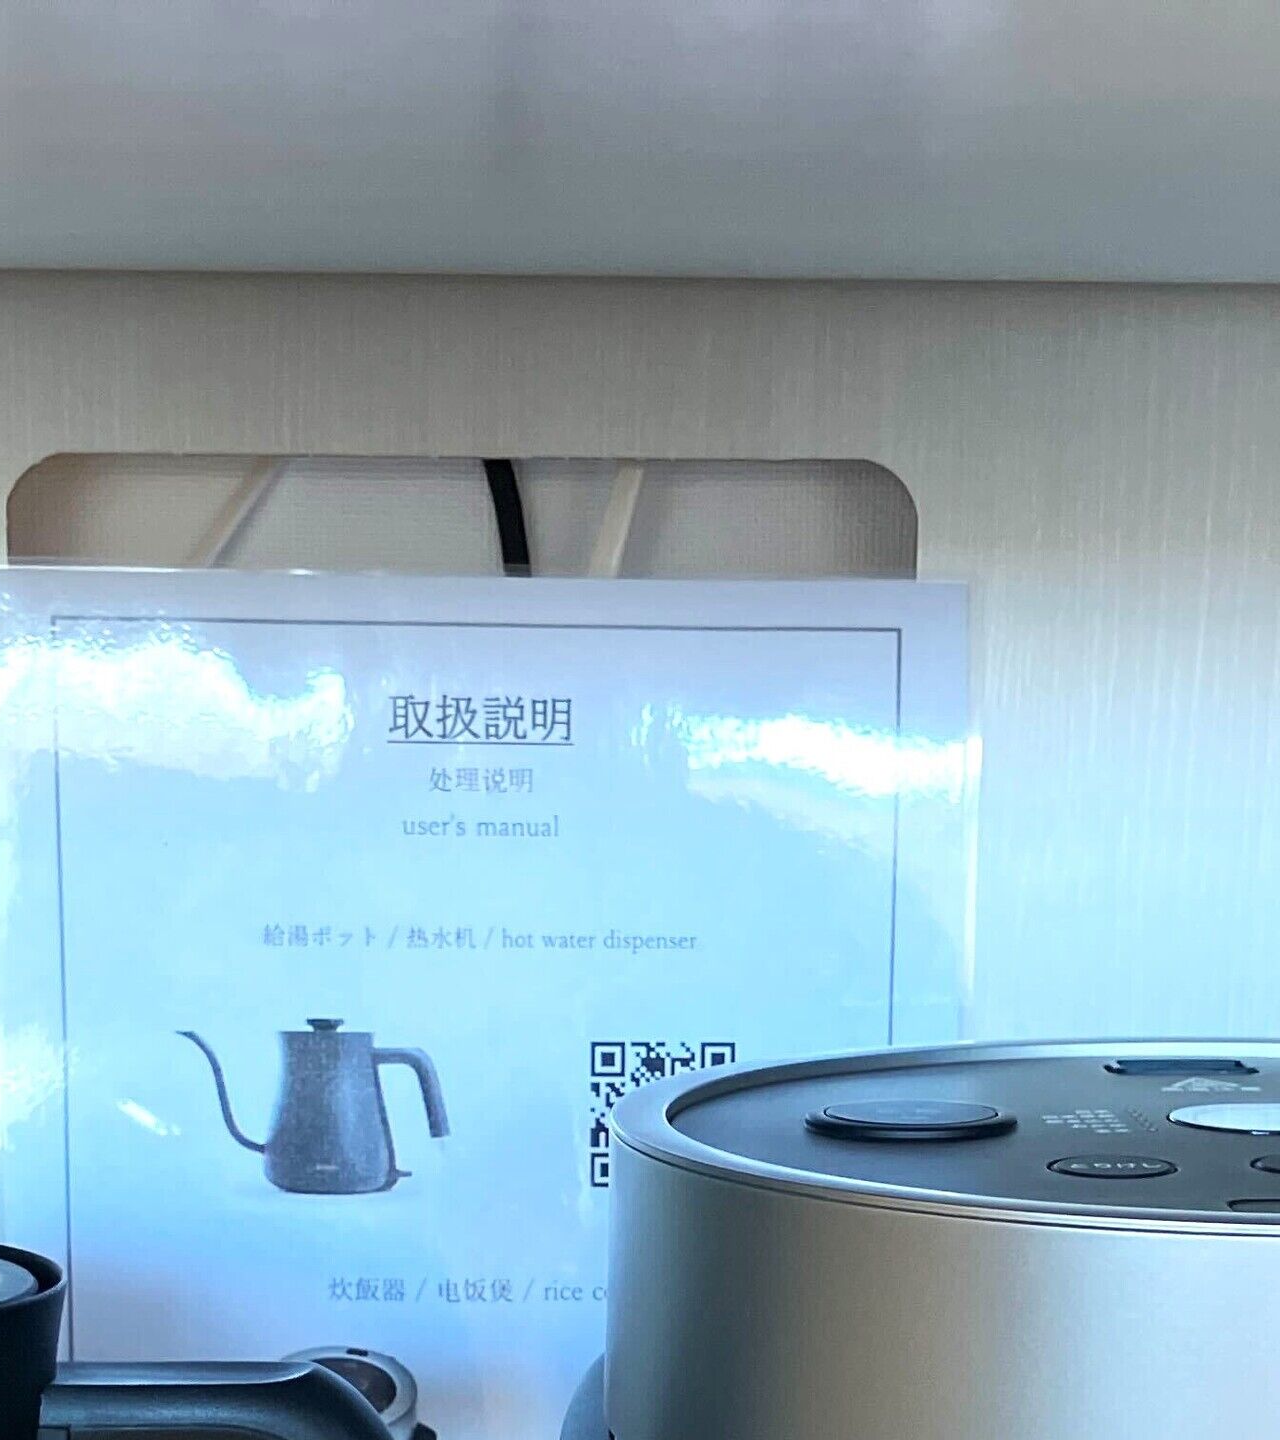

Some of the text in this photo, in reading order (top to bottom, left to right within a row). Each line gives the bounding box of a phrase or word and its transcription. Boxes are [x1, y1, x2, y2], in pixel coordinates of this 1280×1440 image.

[387, 694, 573, 741] 取扱説明
[429, 768, 534, 794] 处理说明
[402, 814, 560, 838] user's manual
[263, 926, 376, 948] 給湯ポット
[407, 927, 477, 949] 热水机
[502, 928, 535, 949] hot
[542, 933, 596, 949] water
[604, 929, 698, 954] dispenser
[329, 1276, 406, 1301] 炊飯器
[438, 1278, 513, 1302] 电饭煲
[544, 1280, 583, 1301] rice
[592, 1284, 608, 1301] c
